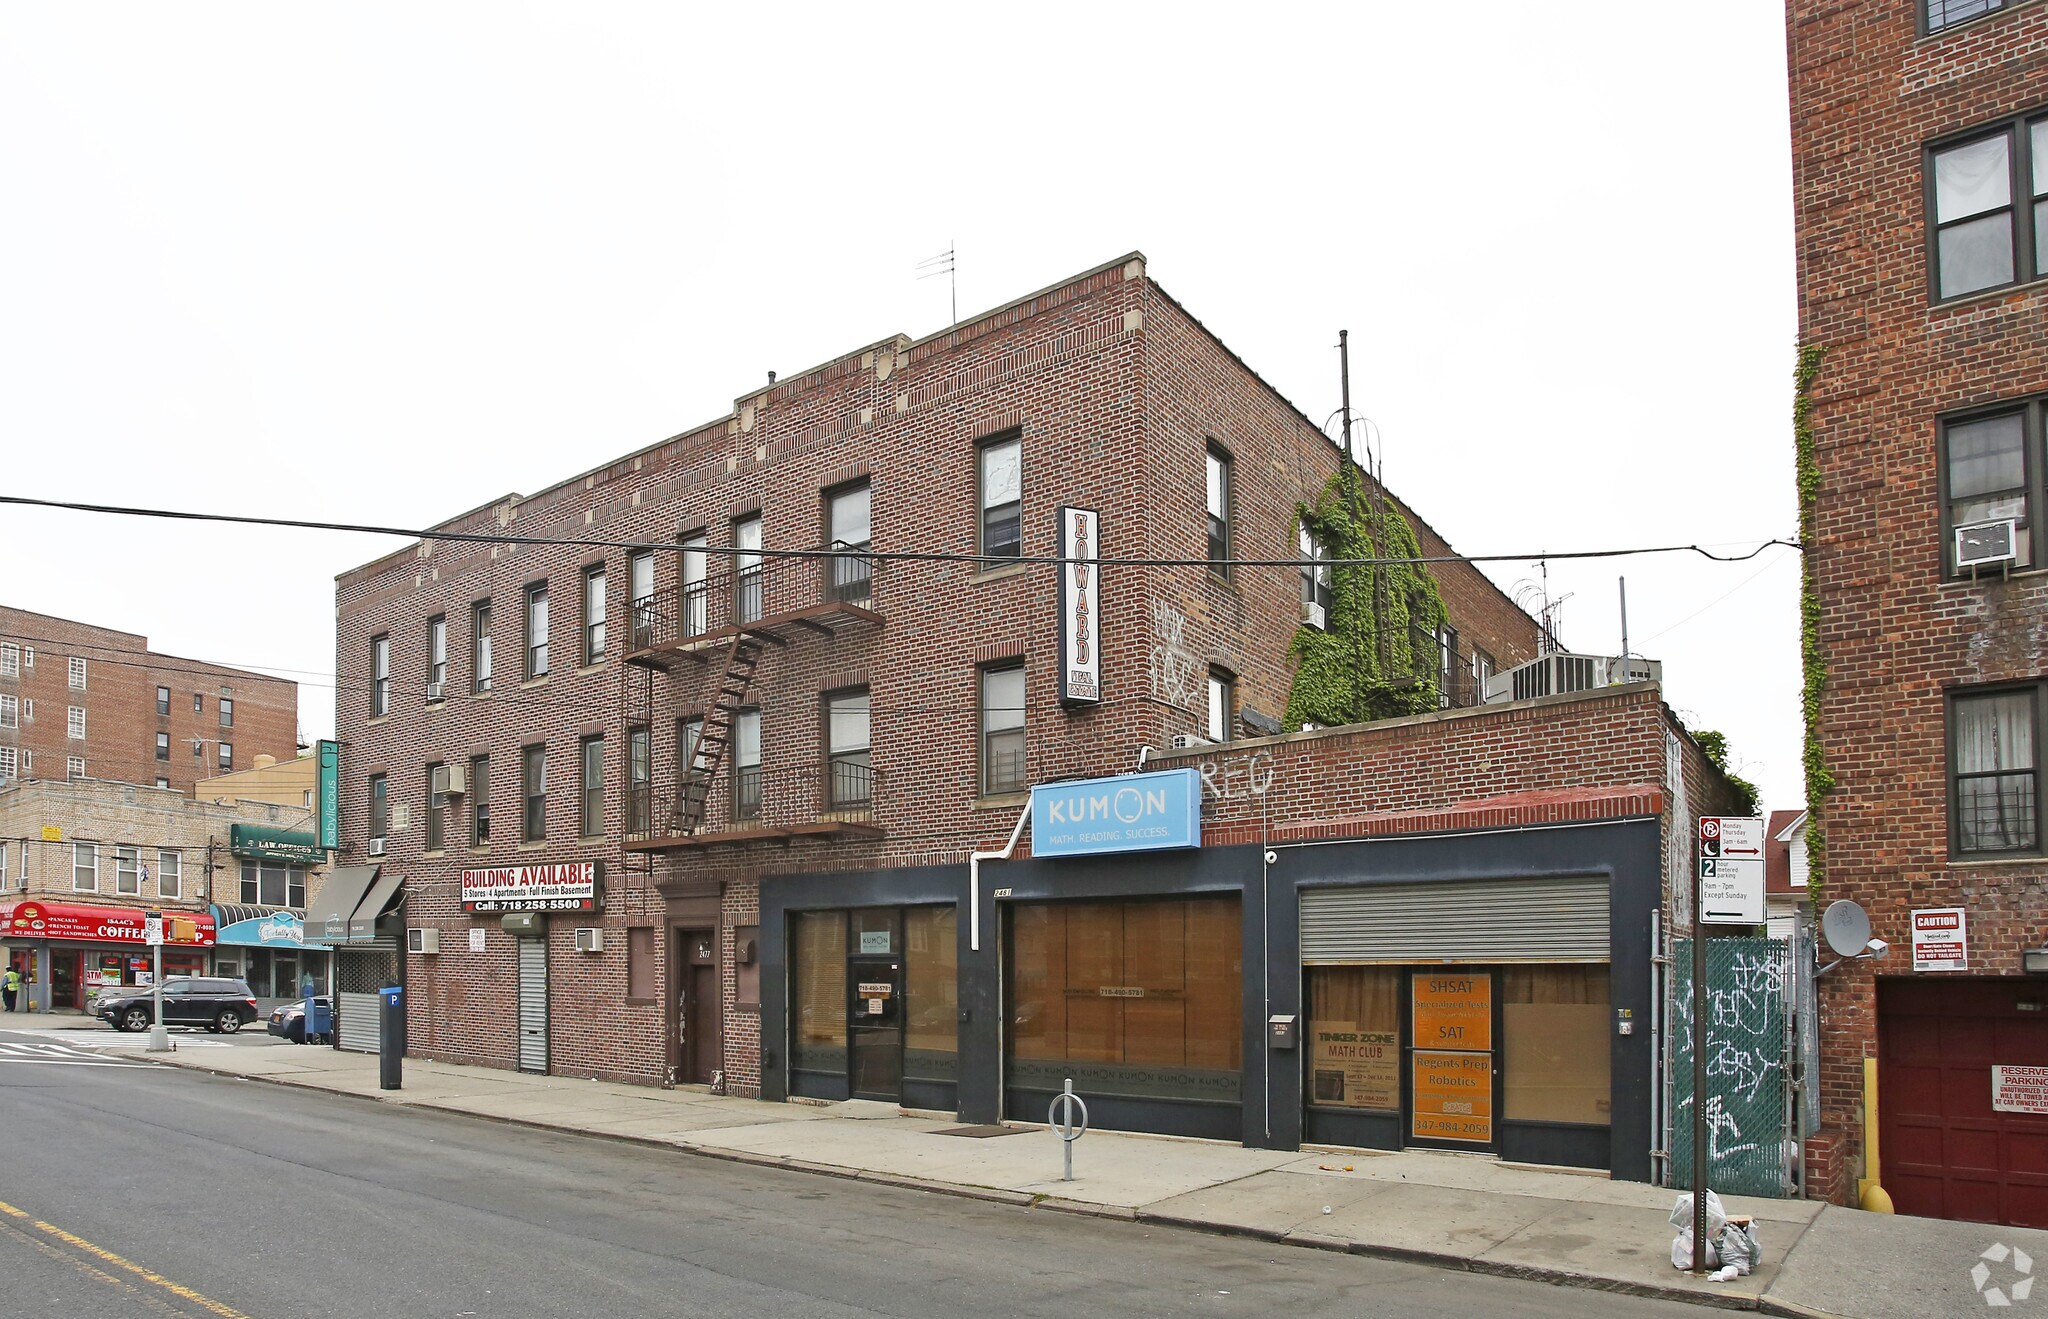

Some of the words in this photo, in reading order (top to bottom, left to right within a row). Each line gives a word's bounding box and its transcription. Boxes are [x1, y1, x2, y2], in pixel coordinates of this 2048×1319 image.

[1073, 514, 1089, 664] HOWARD
[1049, 788, 1166, 824] KUMON
[326, 780, 336, 846] babylicious
[1079, 830, 1122, 842] READING.
[1125, 827, 1170, 839] SUCCESS.
[258, 840, 276, 849] LAW
[1704, 860, 1714, 877] 2
[463, 868, 515, 888] BUILDING
[519, 864, 592, 886] AVAILABLE
[464, 890, 468, 898] 5
[469, 889, 486, 898] Stores
[494, 888, 526, 899] Apartments
[529, 887, 540, 896] Full
[541, 886, 559, 895] Finish
[561, 885, 591, 895] Basement
[475, 901, 499, 911] Call:
[107, 918, 134, 926] ISAAC'S
[1917, 916, 1957, 926] CAUTION
[862, 936, 888, 945] KUMON
[87, 971, 102, 980] ATM
[1430, 980, 1475, 993] SHSAT
[392, 995, 397, 1005] P
[1415, 1000, 1464, 1009] Specialized
[1467, 1000, 1489, 1009] Tests
[1318, 1032, 1358, 1042] TINKER
[1360, 1033, 1395, 1043] ZONE
[1439, 1026, 1465, 1039] SAT
[1328, 1046, 1355, 1057] MATH
[1358, 1046, 1383, 1058] CLUB
[1417, 1057, 1460, 1069] Regents
[1463, 1059, 1488, 1071] Prep
[1044, 1066, 1076, 1076] KUMON
[1081, 1069, 1114, 1079] KUMON
[1119, 1072, 1153, 1082] KUMON
[1159, 1074, 1195, 1085] KUMON
[1199, 1077, 1237, 1088] KUMON
[1429, 1075, 1476, 1086] Robotics
[2000, 1086, 2041, 1094] UNAUTHORIZED
[1416, 1120, 1489, 1134] 347-984-2059
